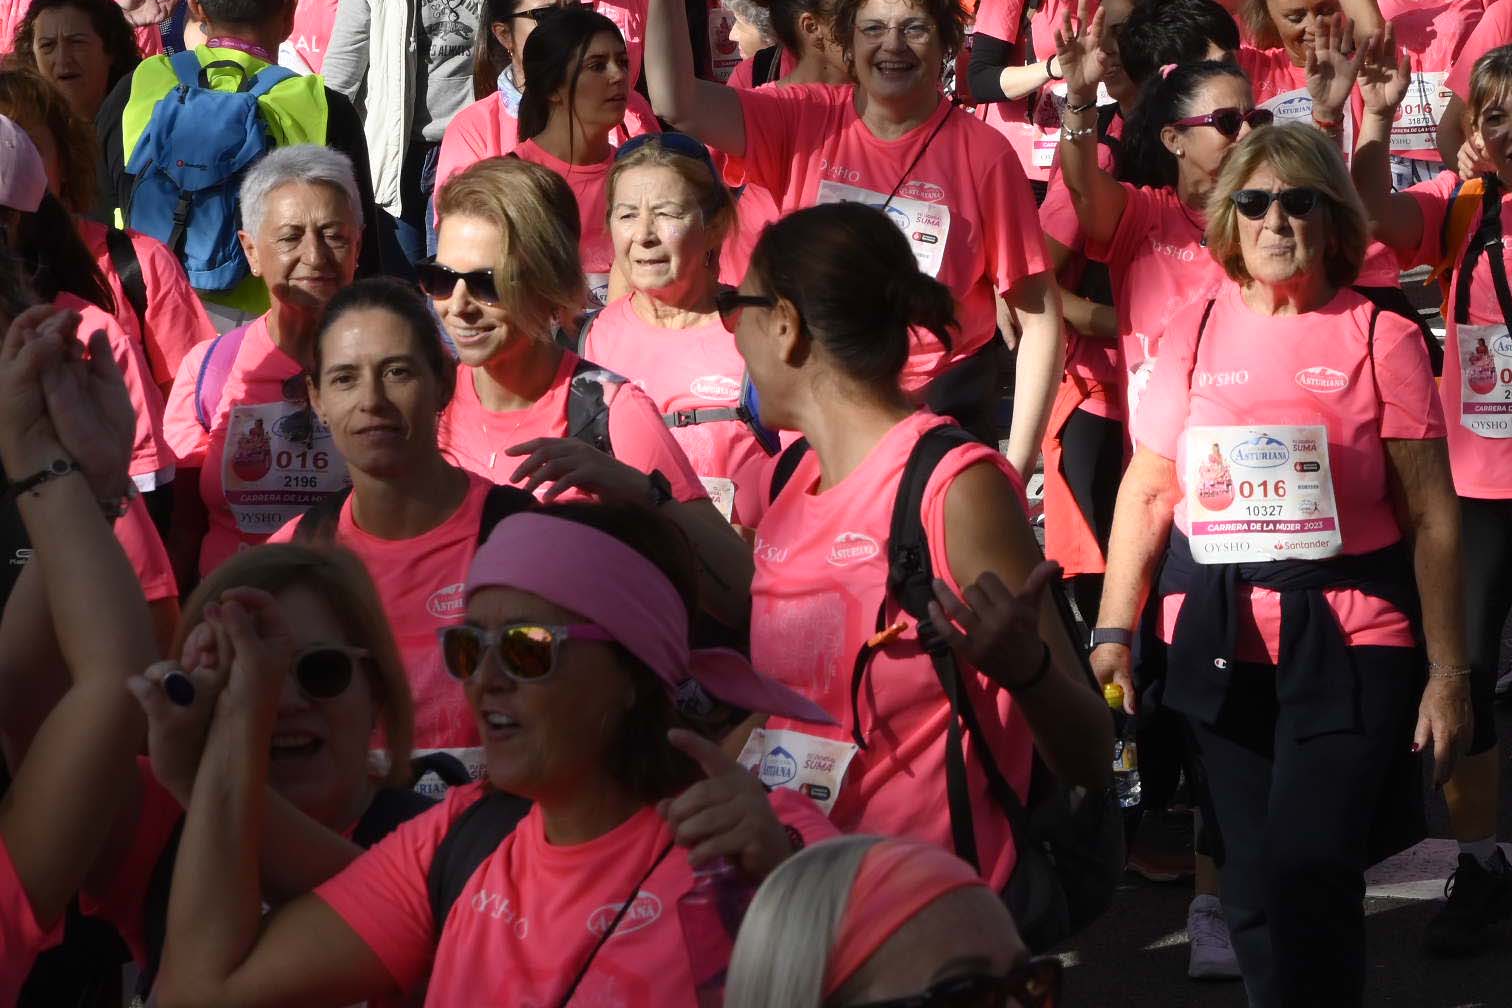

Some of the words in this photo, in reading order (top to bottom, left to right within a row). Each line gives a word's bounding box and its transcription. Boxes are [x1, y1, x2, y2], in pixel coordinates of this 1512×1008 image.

[1277, 105, 1312, 116] ASTURIAN
[1405, 103, 1433, 115] 016
[915, 216, 941, 227] SUMA
[1471, 420, 1507, 430] OYSHO
[1235, 447, 1288, 461] ASTURIANA
[1292, 444, 1318, 452] SUMA
[276, 451, 328, 470] 016
[283, 476, 317, 488] 2196
[1239, 480, 1287, 499] 016
[240, 494, 279, 503] CARRERA
[1246, 505, 1283, 517] 10327
[1207, 522, 1249, 532] CARRERA
[1250, 522, 1262, 531] DE
[1262, 522, 1274, 531] LA
[1276, 522, 1301, 531] MUJER
[1303, 521, 1323, 530] 2023
[1204, 542, 1250, 553] OYSHO
[1284, 539, 1330, 551] Santander
[803, 759, 834, 773] SUMA
